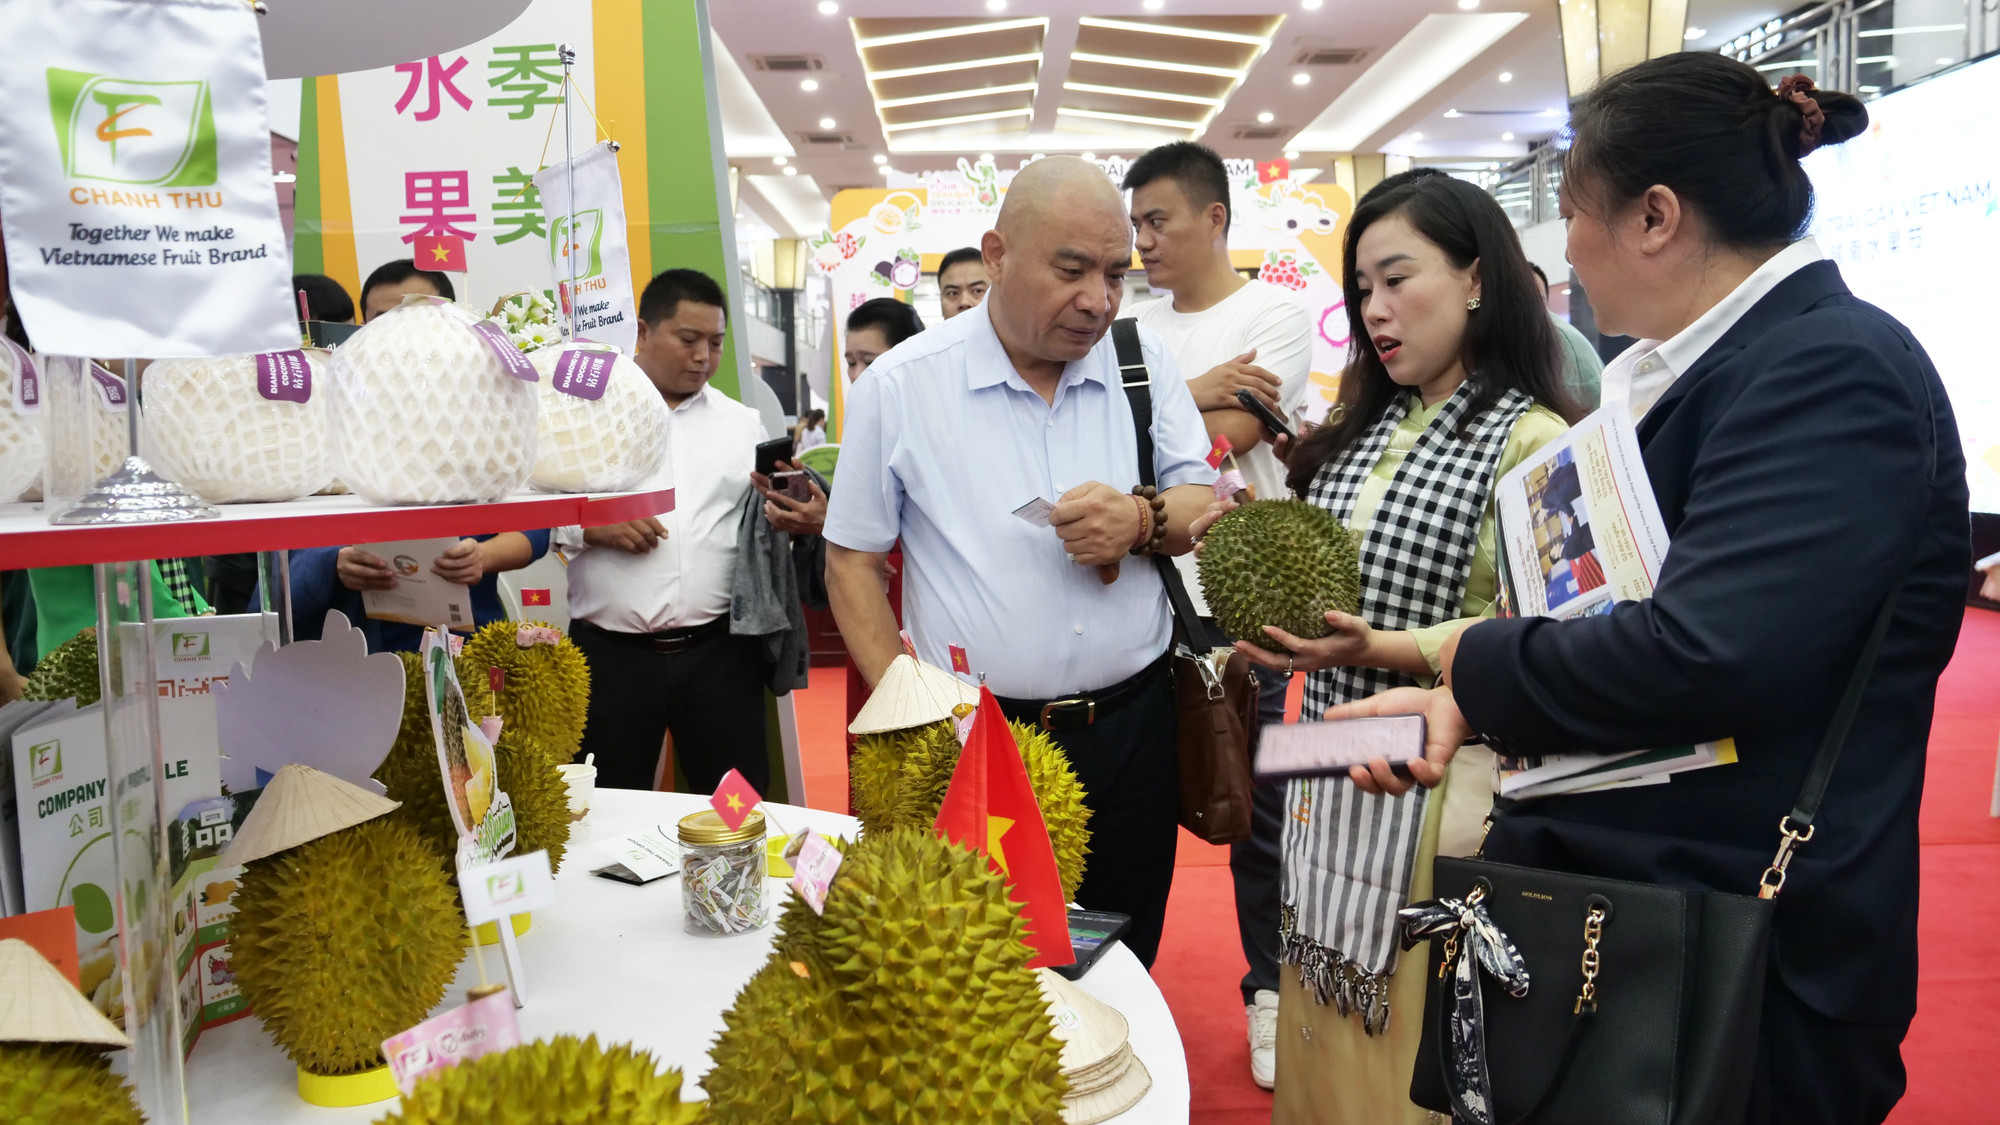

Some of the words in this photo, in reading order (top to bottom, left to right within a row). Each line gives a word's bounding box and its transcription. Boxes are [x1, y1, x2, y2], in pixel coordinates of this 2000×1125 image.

[1230, 163, 1249, 176] AM
[69, 186, 161, 209] CHANH
[166, 191, 223, 209] THU
[68, 222, 152, 245] Together
[154, 225, 180, 243] We
[184, 225, 235, 243] make
[39, 246, 158, 266] Vietnamese
[162, 248, 203, 266] Fruit
[208, 243, 268, 266] Brand
[584, 277, 607, 293] THU
[577, 304, 589, 317] We
[588, 300, 610, 314] make
[582, 319, 597, 332] Fruit
[598, 311, 624, 327] Brand
[267, 357, 278, 394] DIAMOND
[276, 353, 290, 386] COCONUT
[562, 358, 578, 389] DIAMOND
[575, 355, 591, 383] COCONUT
[32, 779, 51, 790] CHANH
[51, 773, 64, 783] THU
[37, 778, 107, 819] COMPANY
